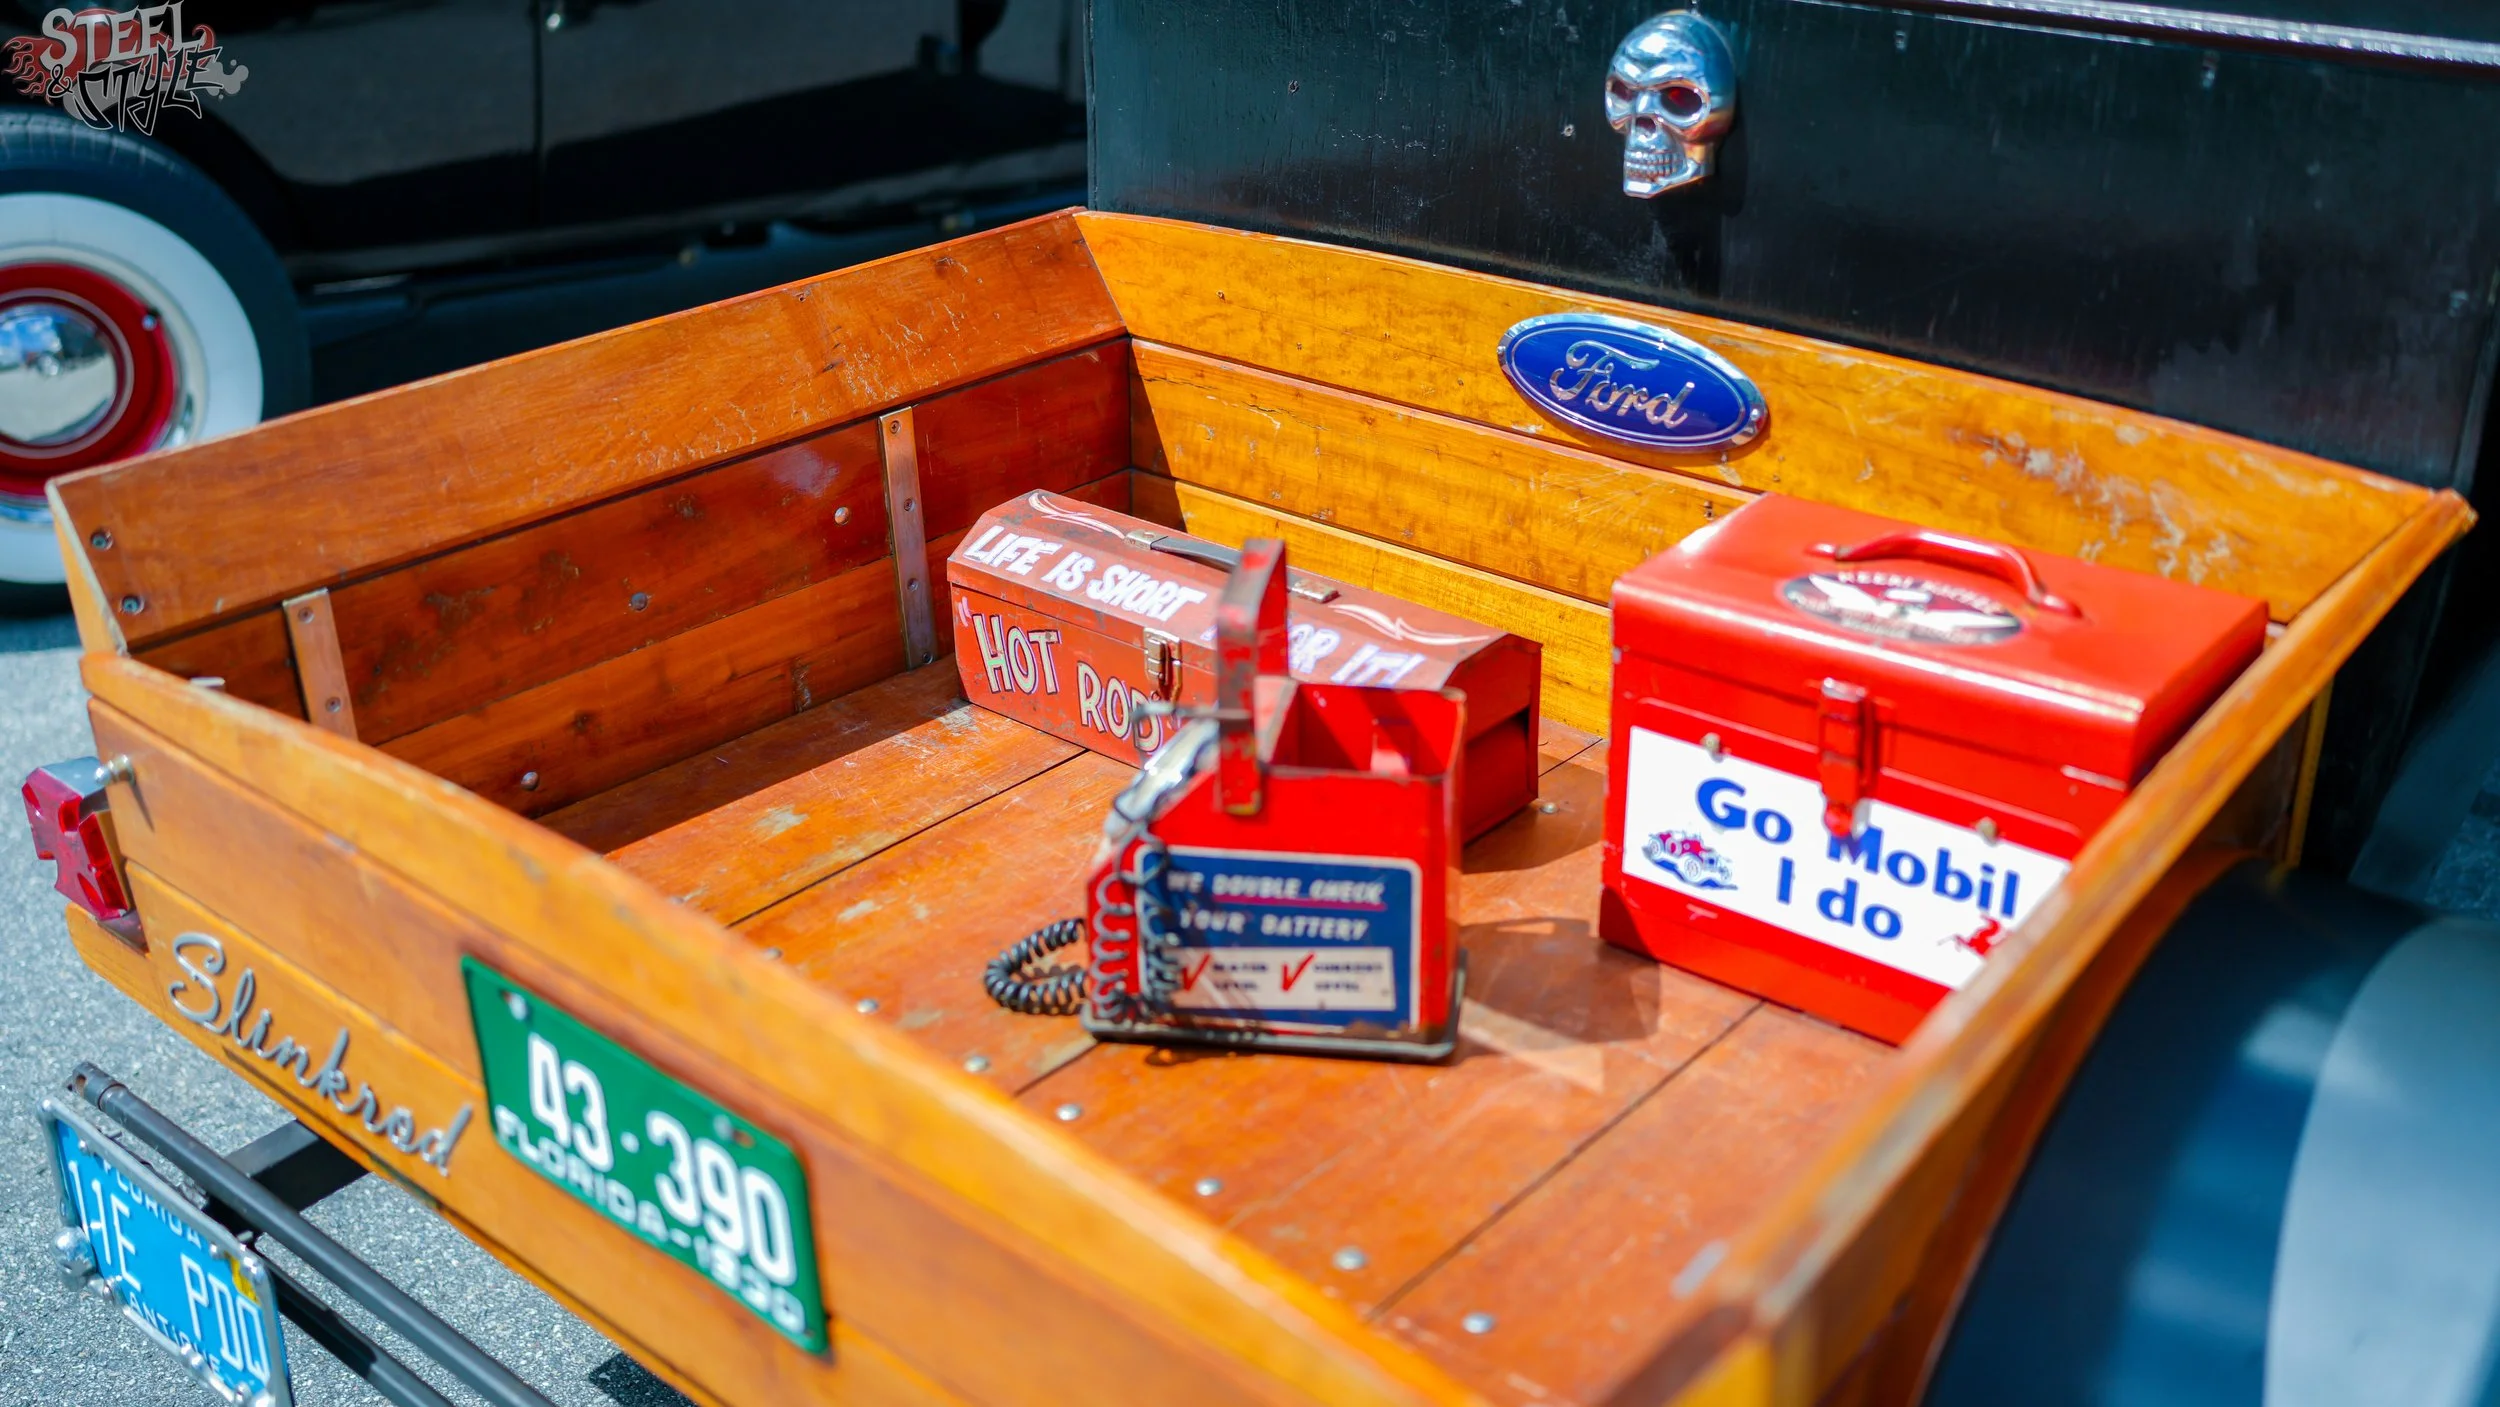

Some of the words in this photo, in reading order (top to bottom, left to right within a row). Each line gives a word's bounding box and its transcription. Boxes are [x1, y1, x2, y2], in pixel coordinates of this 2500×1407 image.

[1550, 339, 1696, 429] Ford
[962, 525, 1063, 576] LIFE
[1040, 551, 1097, 592] IS
[1086, 564, 1208, 622] SHORT
[1212, 873, 1302, 899] DOUBLE
[1309, 879, 1386, 905] CHECK
[1695, 777, 1793, 844] Go
[1826, 825, 2020, 919] Mobil
[1180, 908, 1246, 935] YOUR
[1261, 913, 1370, 942] BATTERY
[1776, 856, 1795, 905] I
[1816, 876, 1903, 940] do
[180, 1252, 271, 1386] PDQ
